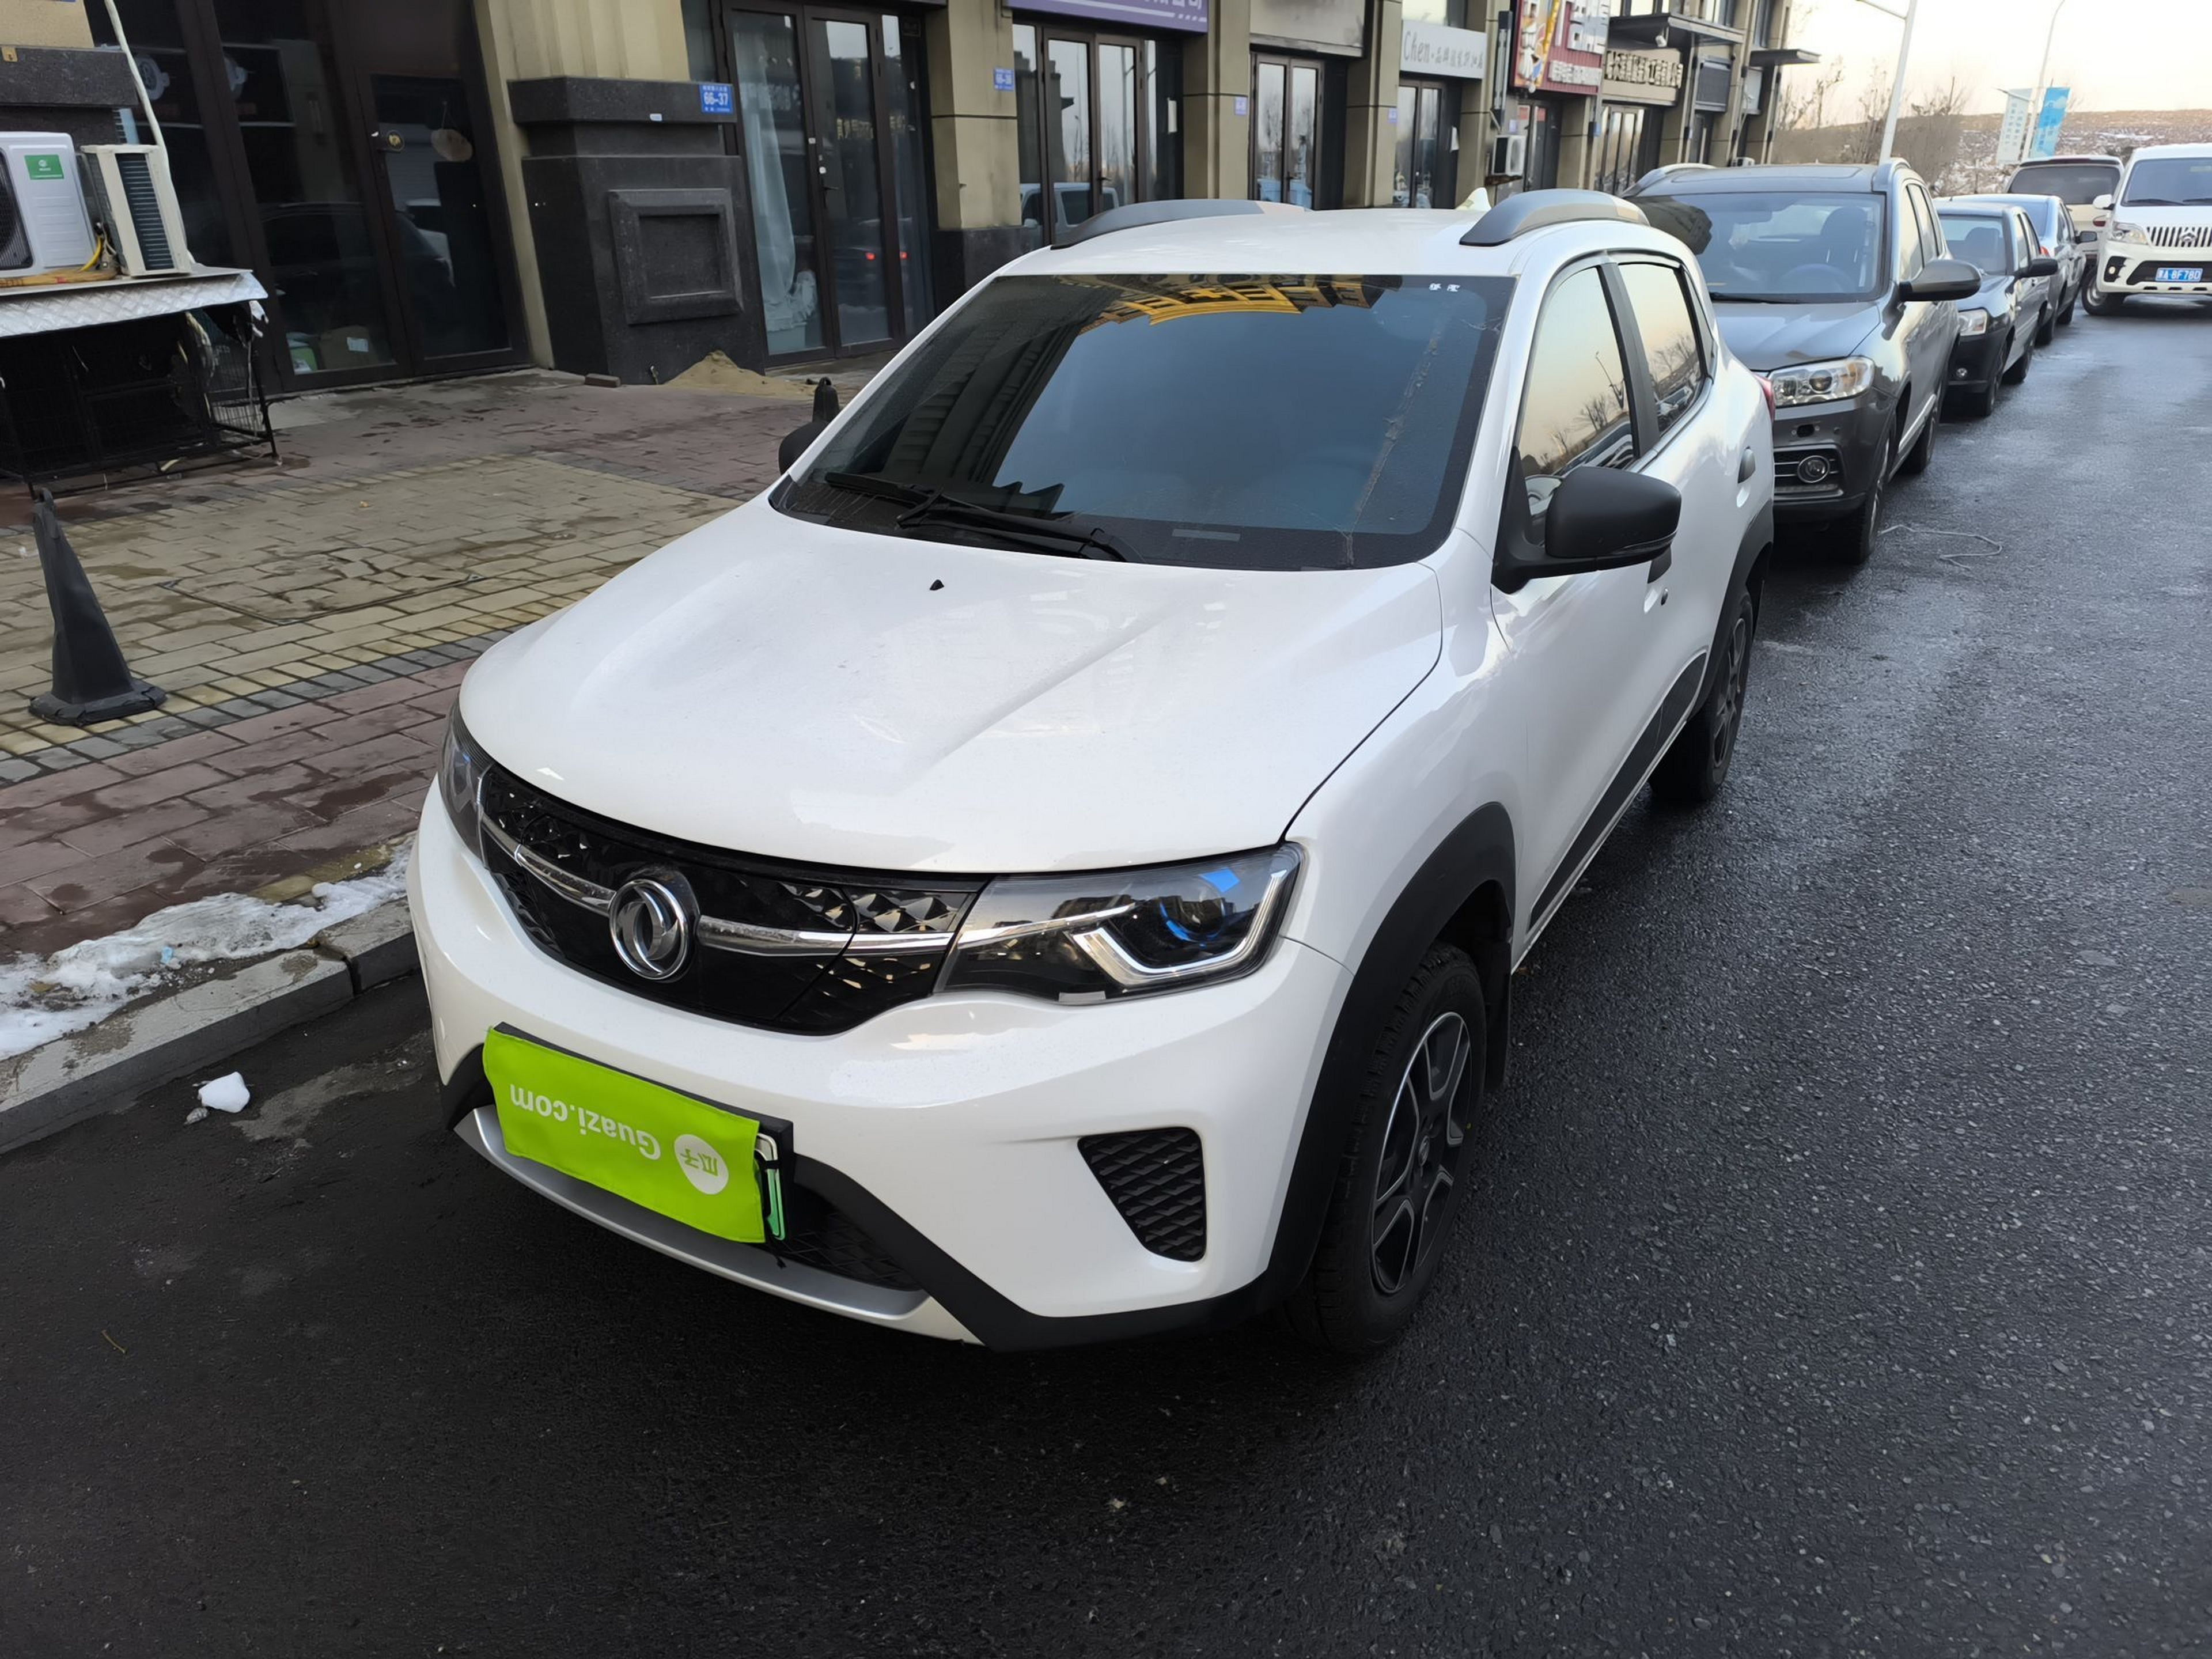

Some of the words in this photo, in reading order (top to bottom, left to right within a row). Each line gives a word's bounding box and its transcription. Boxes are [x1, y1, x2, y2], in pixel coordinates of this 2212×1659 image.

[704, 92, 728, 105] 66-37
[510, 1084, 661, 1160] Guazi.com
[680, 1147, 718, 1177] 瓜子
